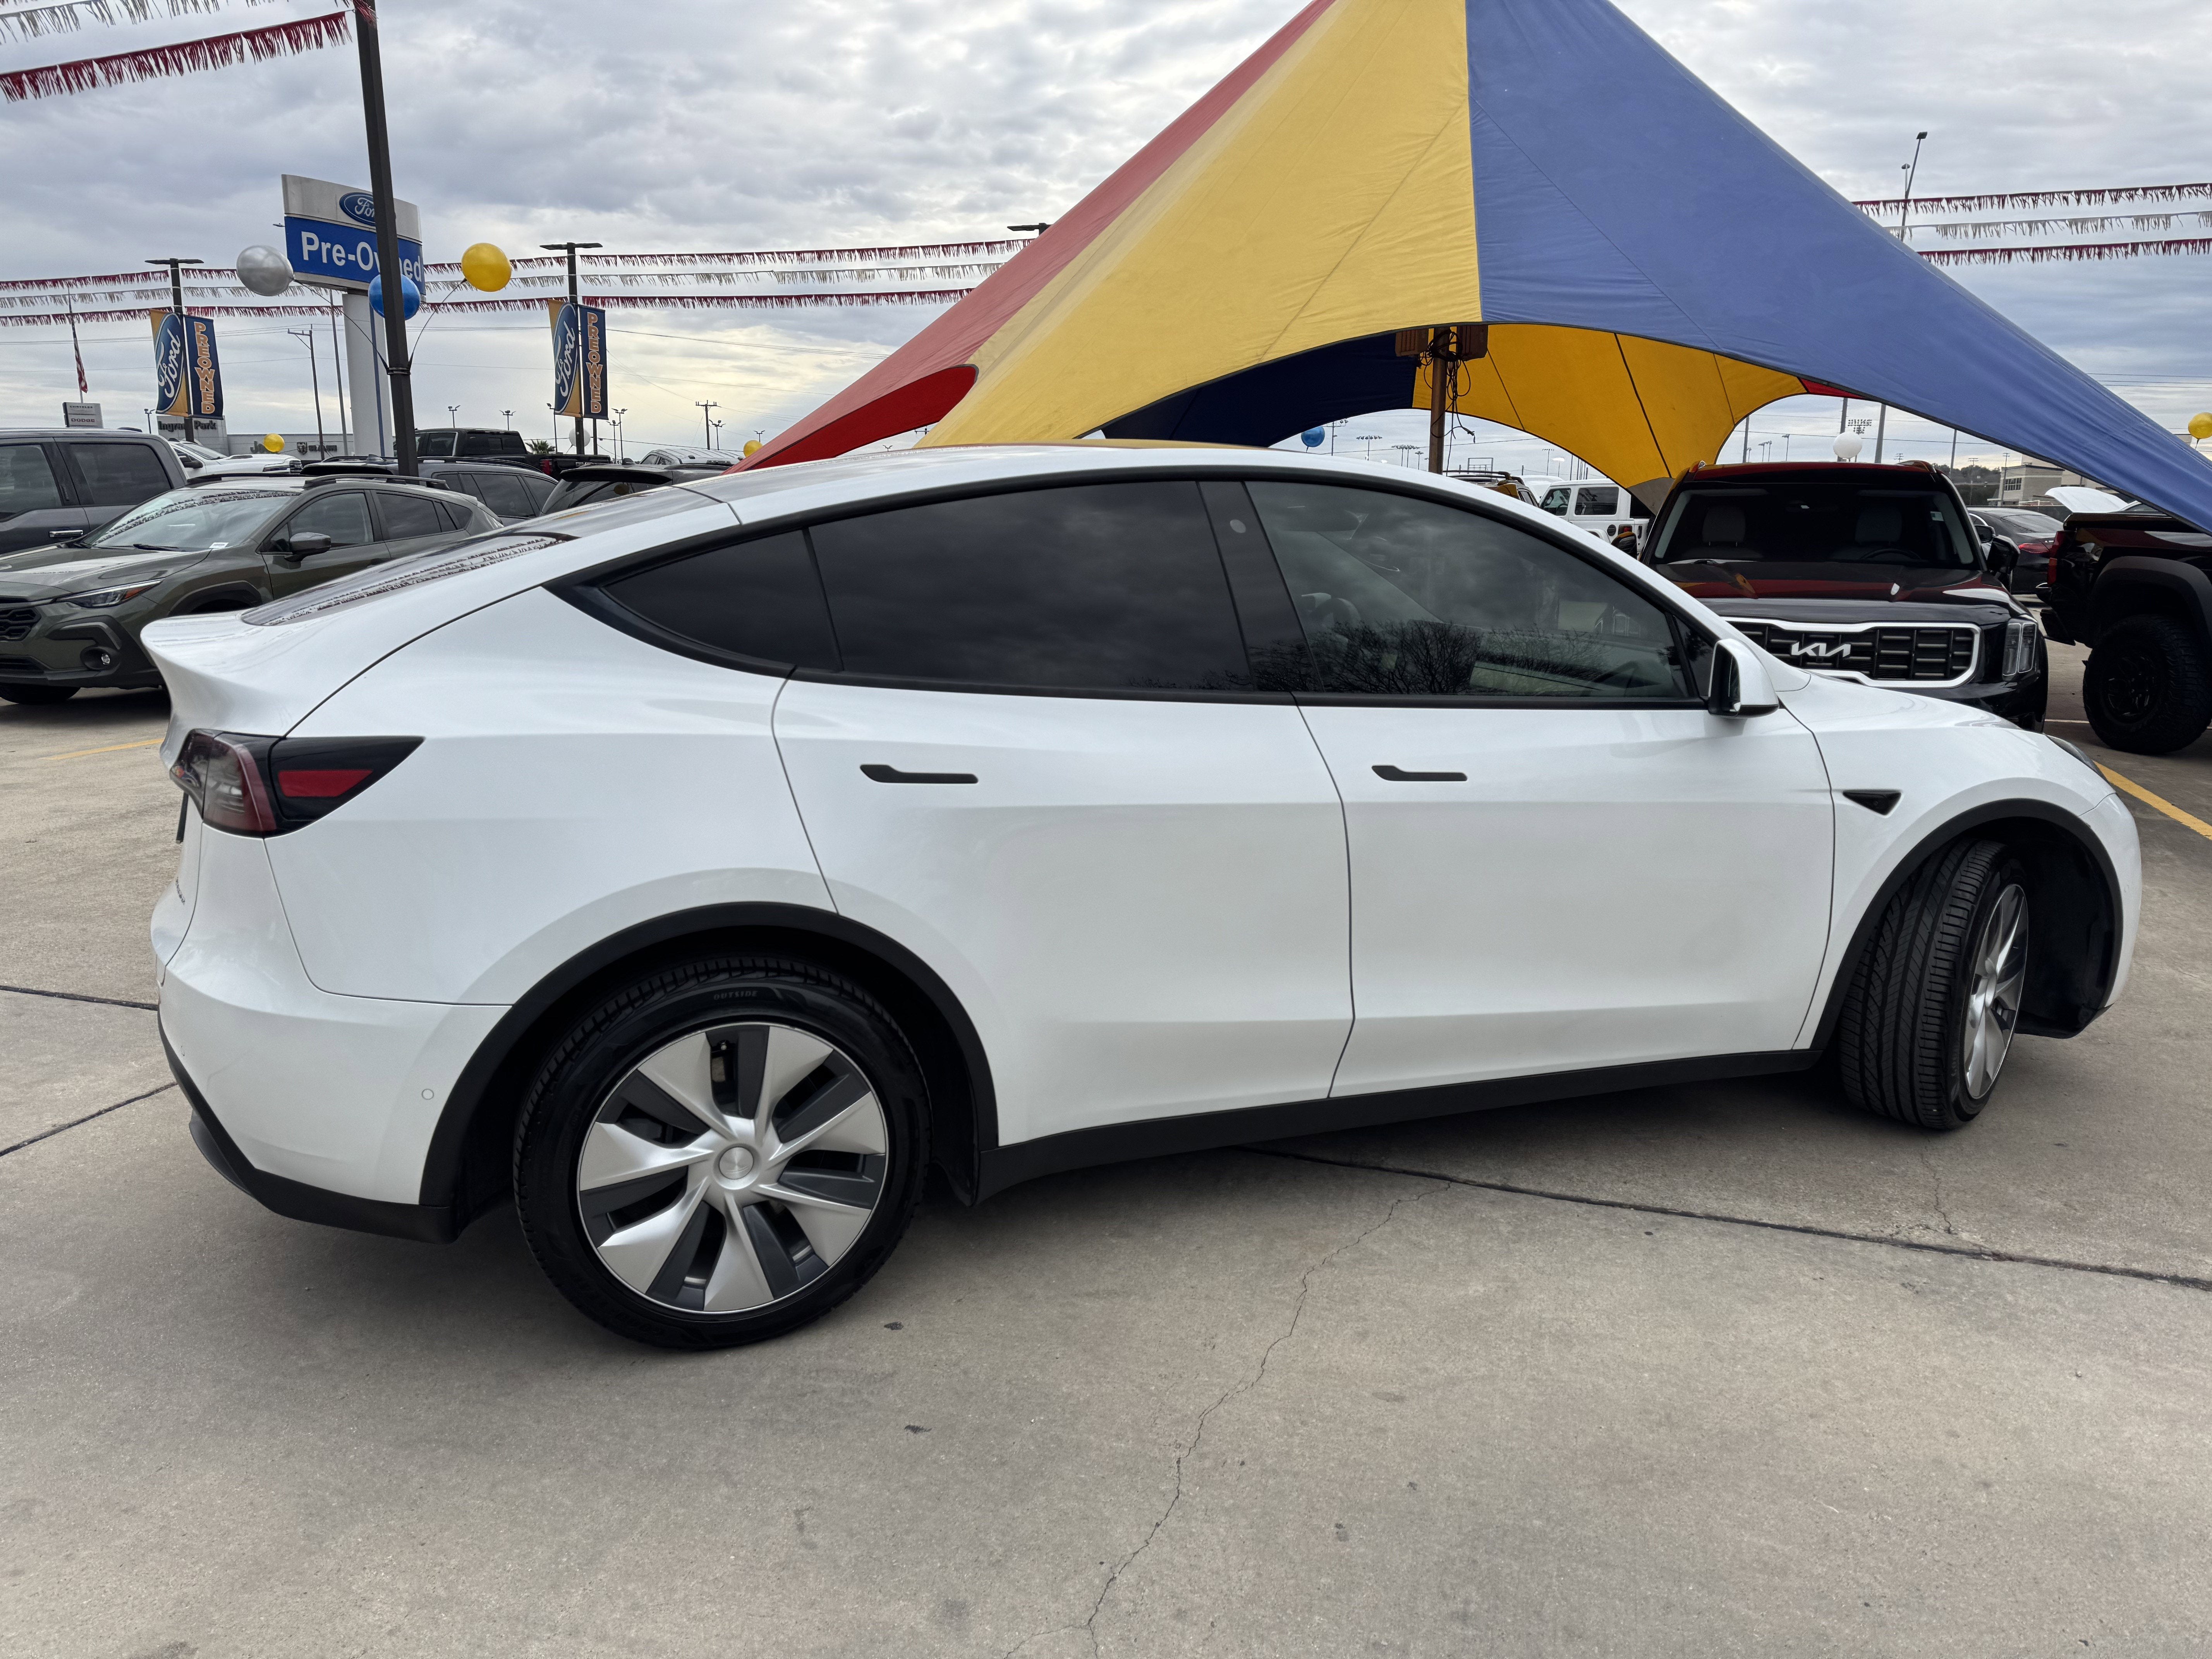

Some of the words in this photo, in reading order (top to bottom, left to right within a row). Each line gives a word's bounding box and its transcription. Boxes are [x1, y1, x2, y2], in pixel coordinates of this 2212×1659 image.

[355, 197, 374, 217] For
[301, 231, 421, 282] Pre-Oed
[157, 328, 181, 398] Ford
[194, 321, 215, 414] PREOWNED
[555, 321, 575, 397] Ford
[586, 312, 603, 413] PREOWNED
[194, 420, 216, 429] Park
[1791, 641, 1851, 658] KIA
[713, 991, 758, 1001] OUTSIDE
